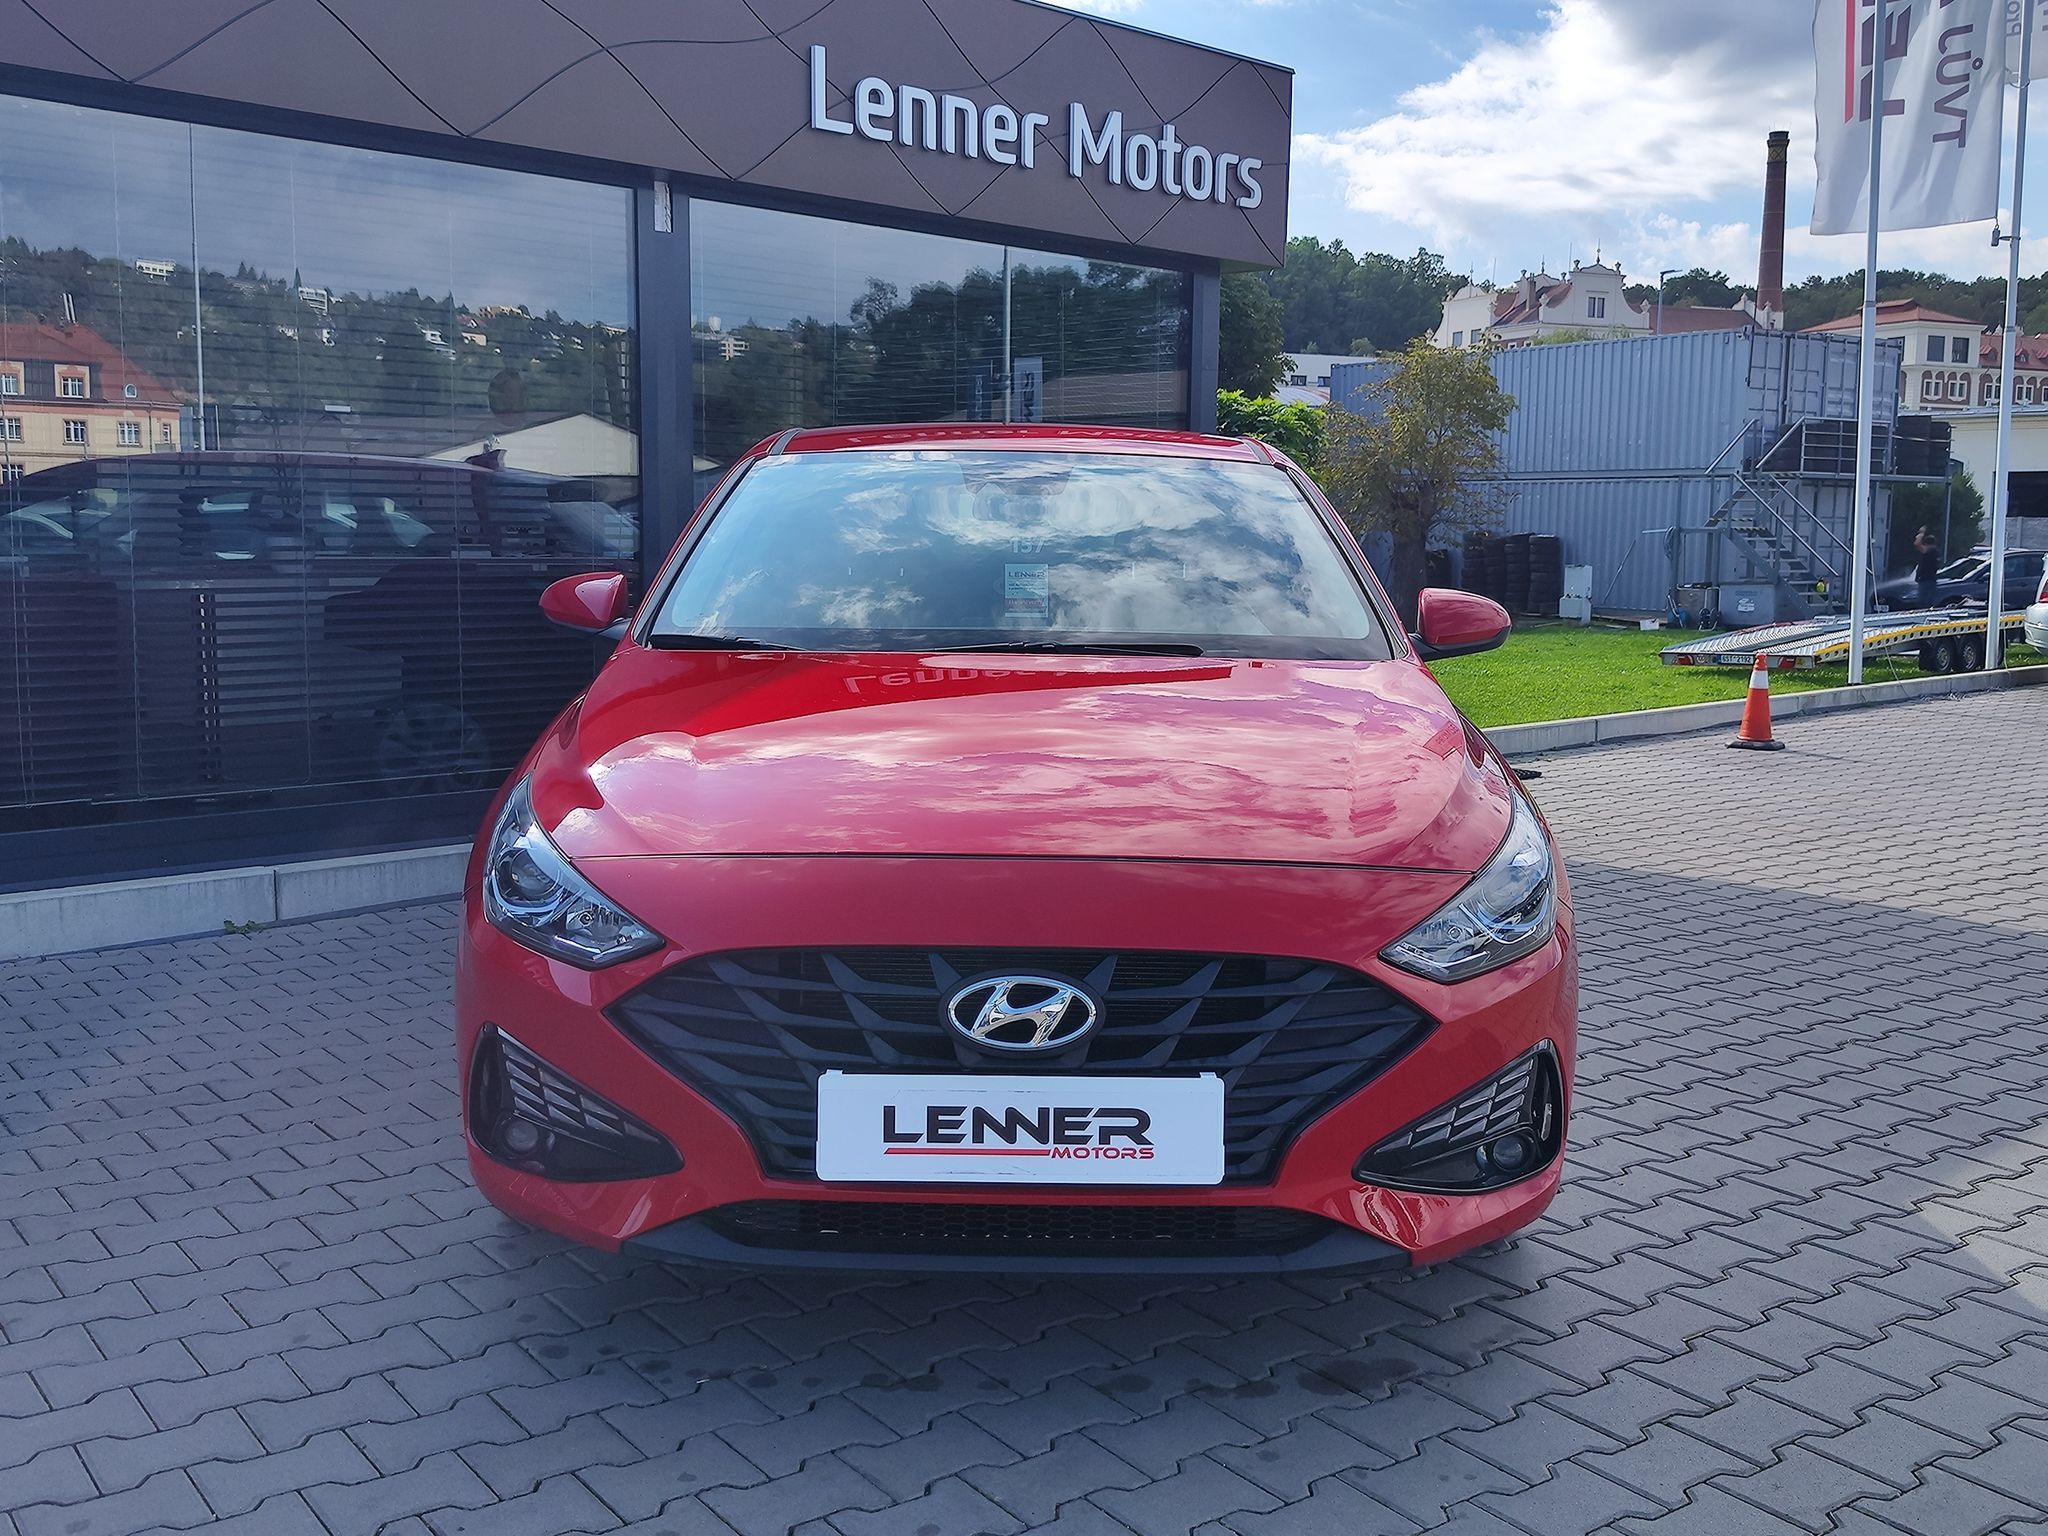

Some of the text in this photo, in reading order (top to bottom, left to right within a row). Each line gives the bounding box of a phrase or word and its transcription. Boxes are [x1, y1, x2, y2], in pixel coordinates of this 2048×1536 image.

[810, 44, 1263, 210] Lenner Motors
[1010, 535, 1045, 554] 157
[883, 1105, 1154, 1145] LENNER
[1050, 1146, 1155, 1160] MOTORS
